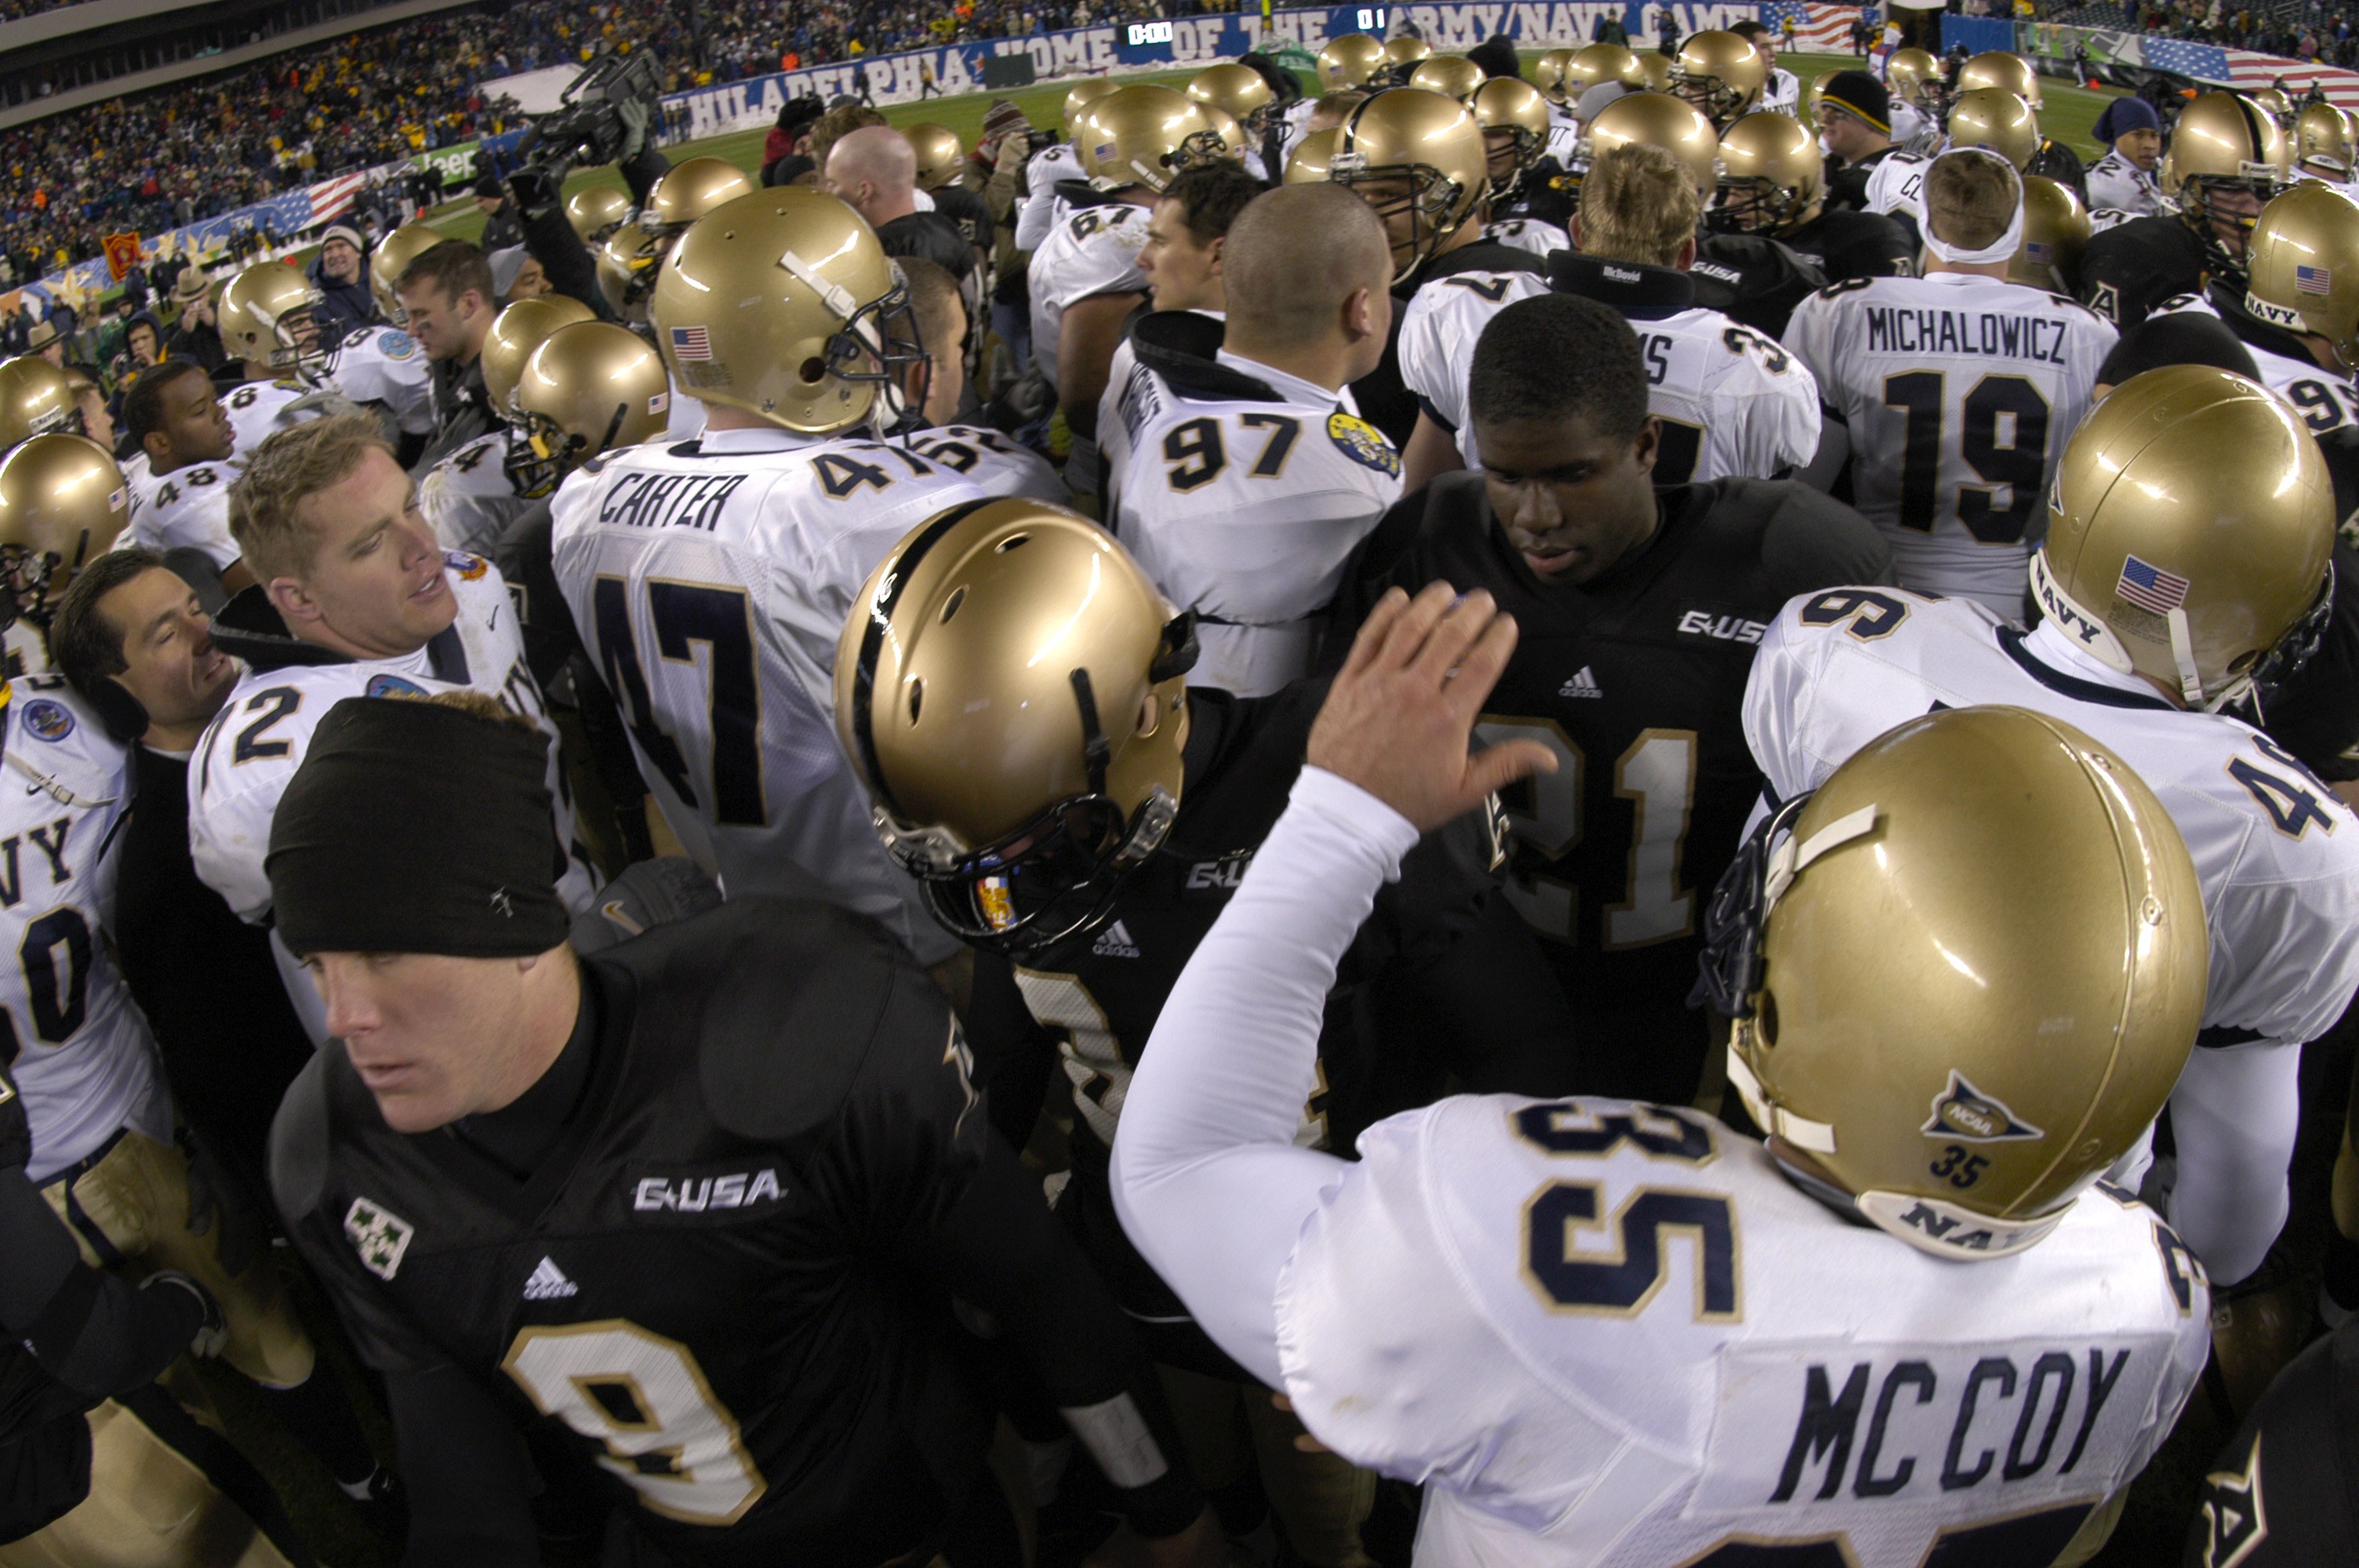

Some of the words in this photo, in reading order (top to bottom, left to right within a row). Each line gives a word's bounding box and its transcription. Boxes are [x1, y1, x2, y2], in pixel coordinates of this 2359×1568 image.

[1128, 22, 1172, 45] 0:00
[1172, 18, 1225, 60] OF
[1240, 11, 1330, 53] THE
[1357, 9, 1385, 29] 01
[1070, 205, 1136, 243] 67
[1603, 266, 1641, 282] McDavid
[2246, 295, 2297, 325] NAVY
[1866, 307, 2066, 365] MICHALOWICZ
[808, 443, 936, 502] 47
[1161, 412, 1303, 495] 97
[1882, 368, 2052, 546] 19
[156, 467, 219, 510] 48
[598, 471, 749, 532] CARTER
[1558, 687, 1603, 699] adidas
[1092, 943, 1140, 958] adidas
[1949, 1103, 1994, 1137] NCAA
[1930, 1145, 1990, 1189] 35
[1505, 1100, 1744, 1325] 35
[500, 1318, 768, 1526] 9
